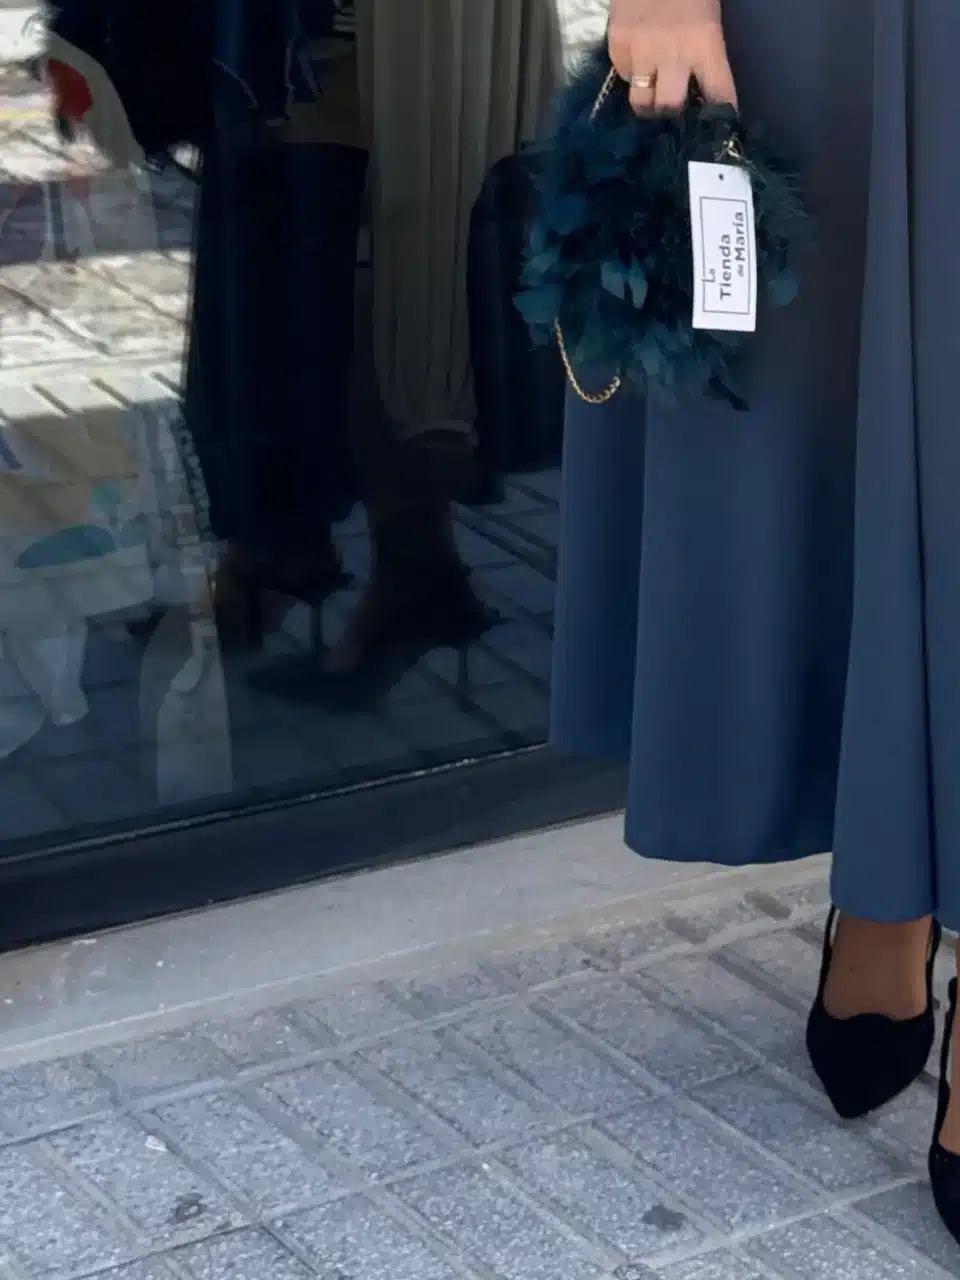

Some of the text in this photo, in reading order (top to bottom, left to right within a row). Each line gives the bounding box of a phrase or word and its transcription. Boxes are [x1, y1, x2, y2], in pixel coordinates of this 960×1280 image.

[732, 211, 746, 262] María
[701, 268, 716, 283] La
[719, 233, 732, 301] Tienda
